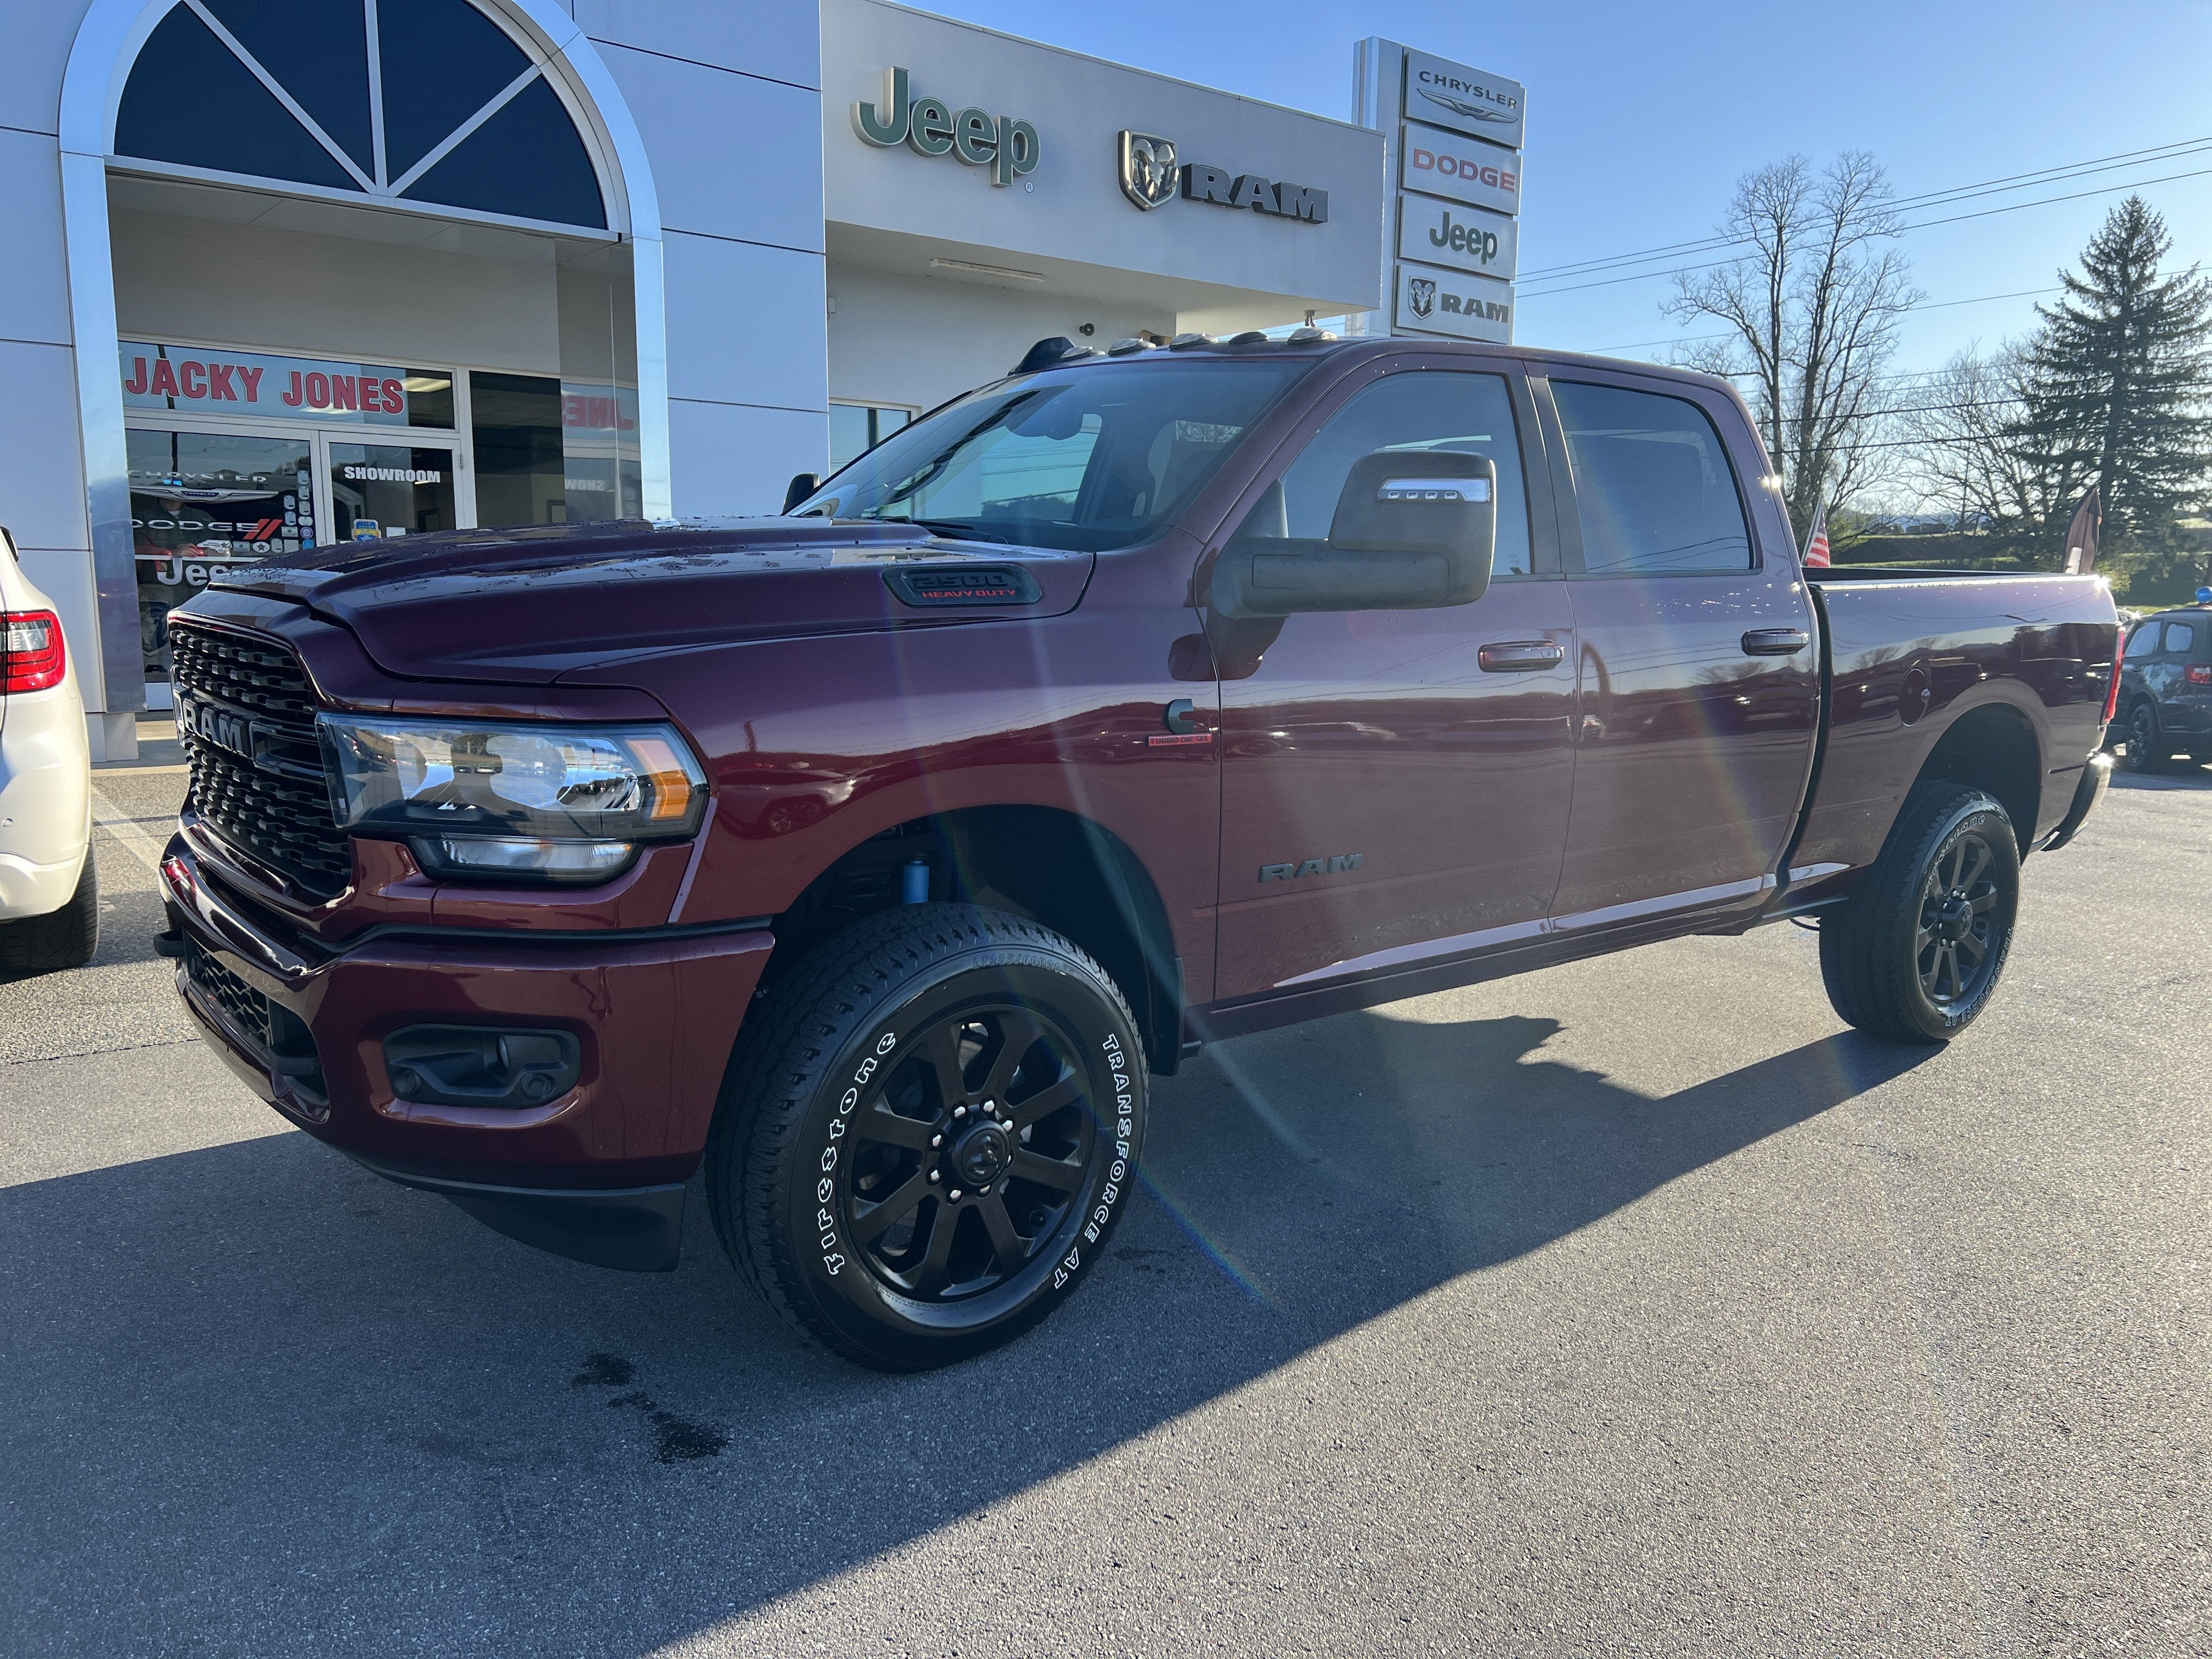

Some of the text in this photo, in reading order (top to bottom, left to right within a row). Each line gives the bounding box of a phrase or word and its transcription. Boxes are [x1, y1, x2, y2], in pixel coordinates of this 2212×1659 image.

[1418, 70, 1517, 110] CHRYSLER
[850, 66, 1041, 188] Jeep
[1182, 163, 1328, 224] RAM
[1413, 148, 1515, 193] DODGE
[1429, 211, 1498, 264] Jeep
[1441, 293, 1509, 323] RAM
[125, 357, 404, 414] JACKY JONES
[128, 470, 267, 483] CHRYSLER
[344, 466, 441, 483] SHOWROOM
[182, 697, 247, 755] RAM
[1258, 852, 1363, 883] RAM
[1945, 927, 2015, 1026] TRANSFORCE AT
[817, 1032, 896, 1276] Firestone
[1054, 1033, 1132, 1289] TRANSFORCE AT
